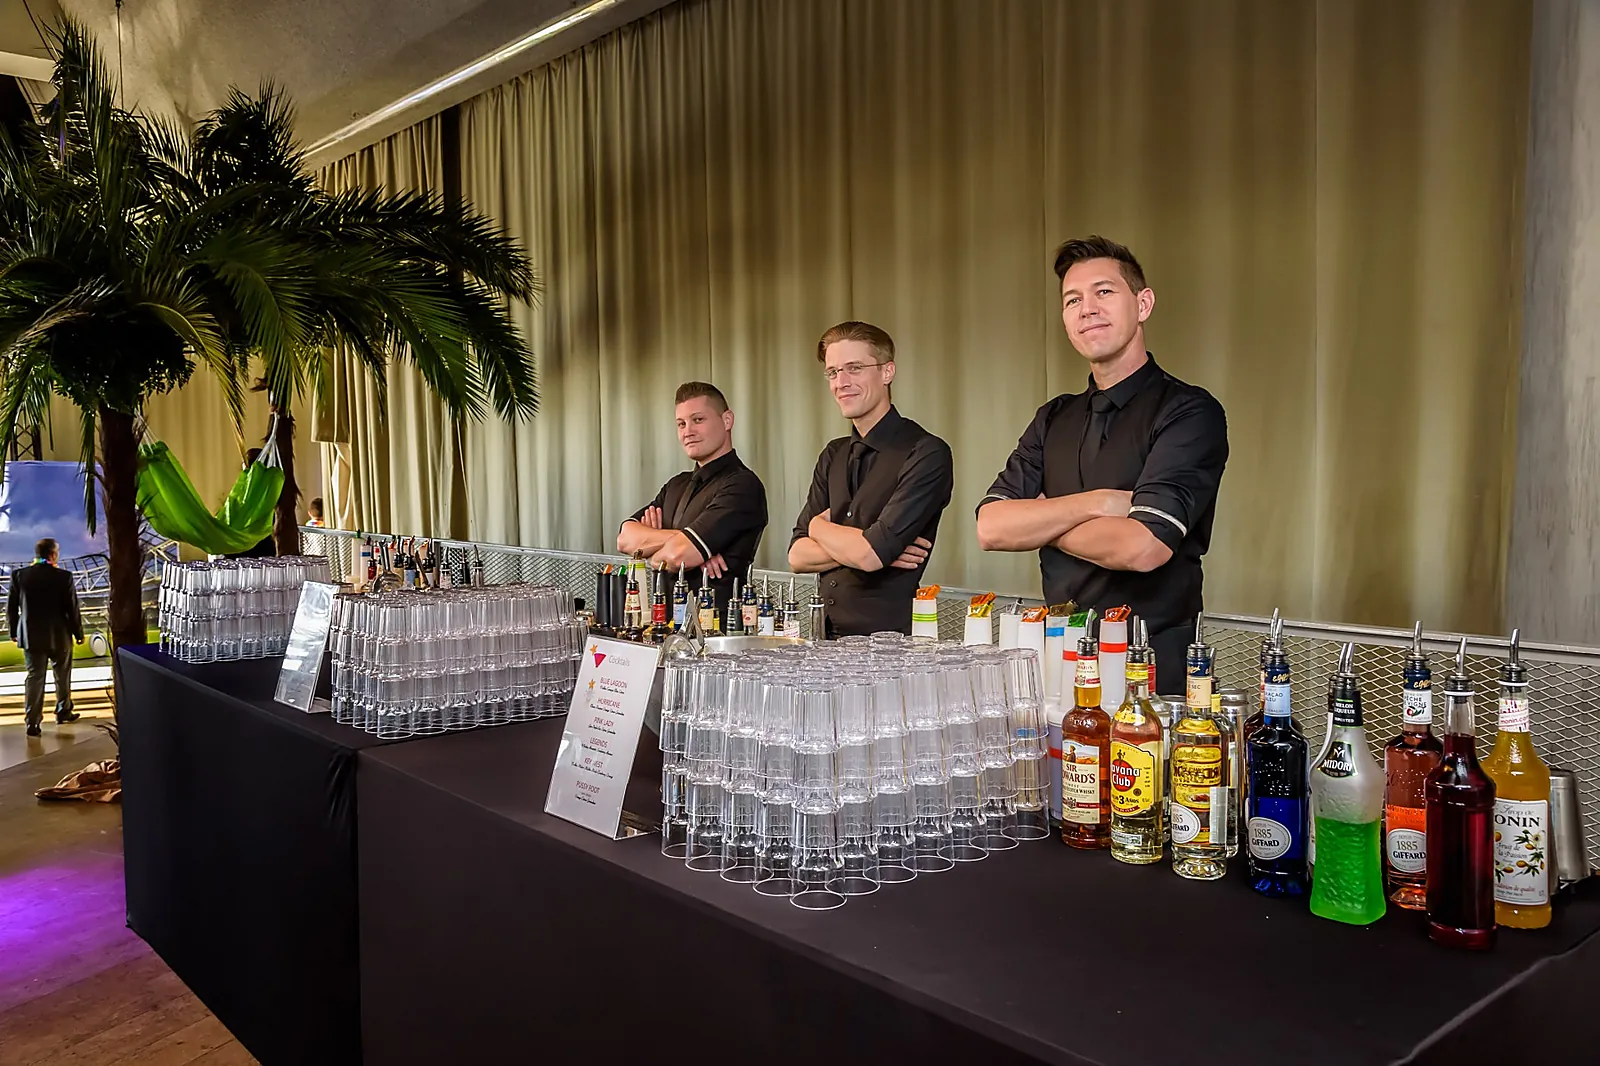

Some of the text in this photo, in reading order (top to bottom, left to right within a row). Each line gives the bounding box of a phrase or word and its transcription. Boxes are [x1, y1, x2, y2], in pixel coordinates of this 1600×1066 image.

[608, 655, 631, 667] Cocktails
[600, 677, 628, 689] BLUE LAGOON
[597, 698, 621, 709] HURRICANE
[589, 737, 609, 748] LEGENDS
[1065, 763, 1078, 773] SIR
[1111, 764, 1141, 778] avana
[1321, 759, 1353, 772] MIDORI
[1062, 769, 1097, 785] DWARD'S
[1112, 773, 1131, 788] Club
[1079, 788, 1096, 796] WHISKY
[1118, 795, 1125, 805] 3
[1494, 814, 1541, 828] ONIN
[1254, 828, 1272, 839] 1885
[1251, 837, 1280, 848] GIFFARD
[1396, 840, 1419, 851] 1885
[1392, 850, 1427, 860] GIFFARD
